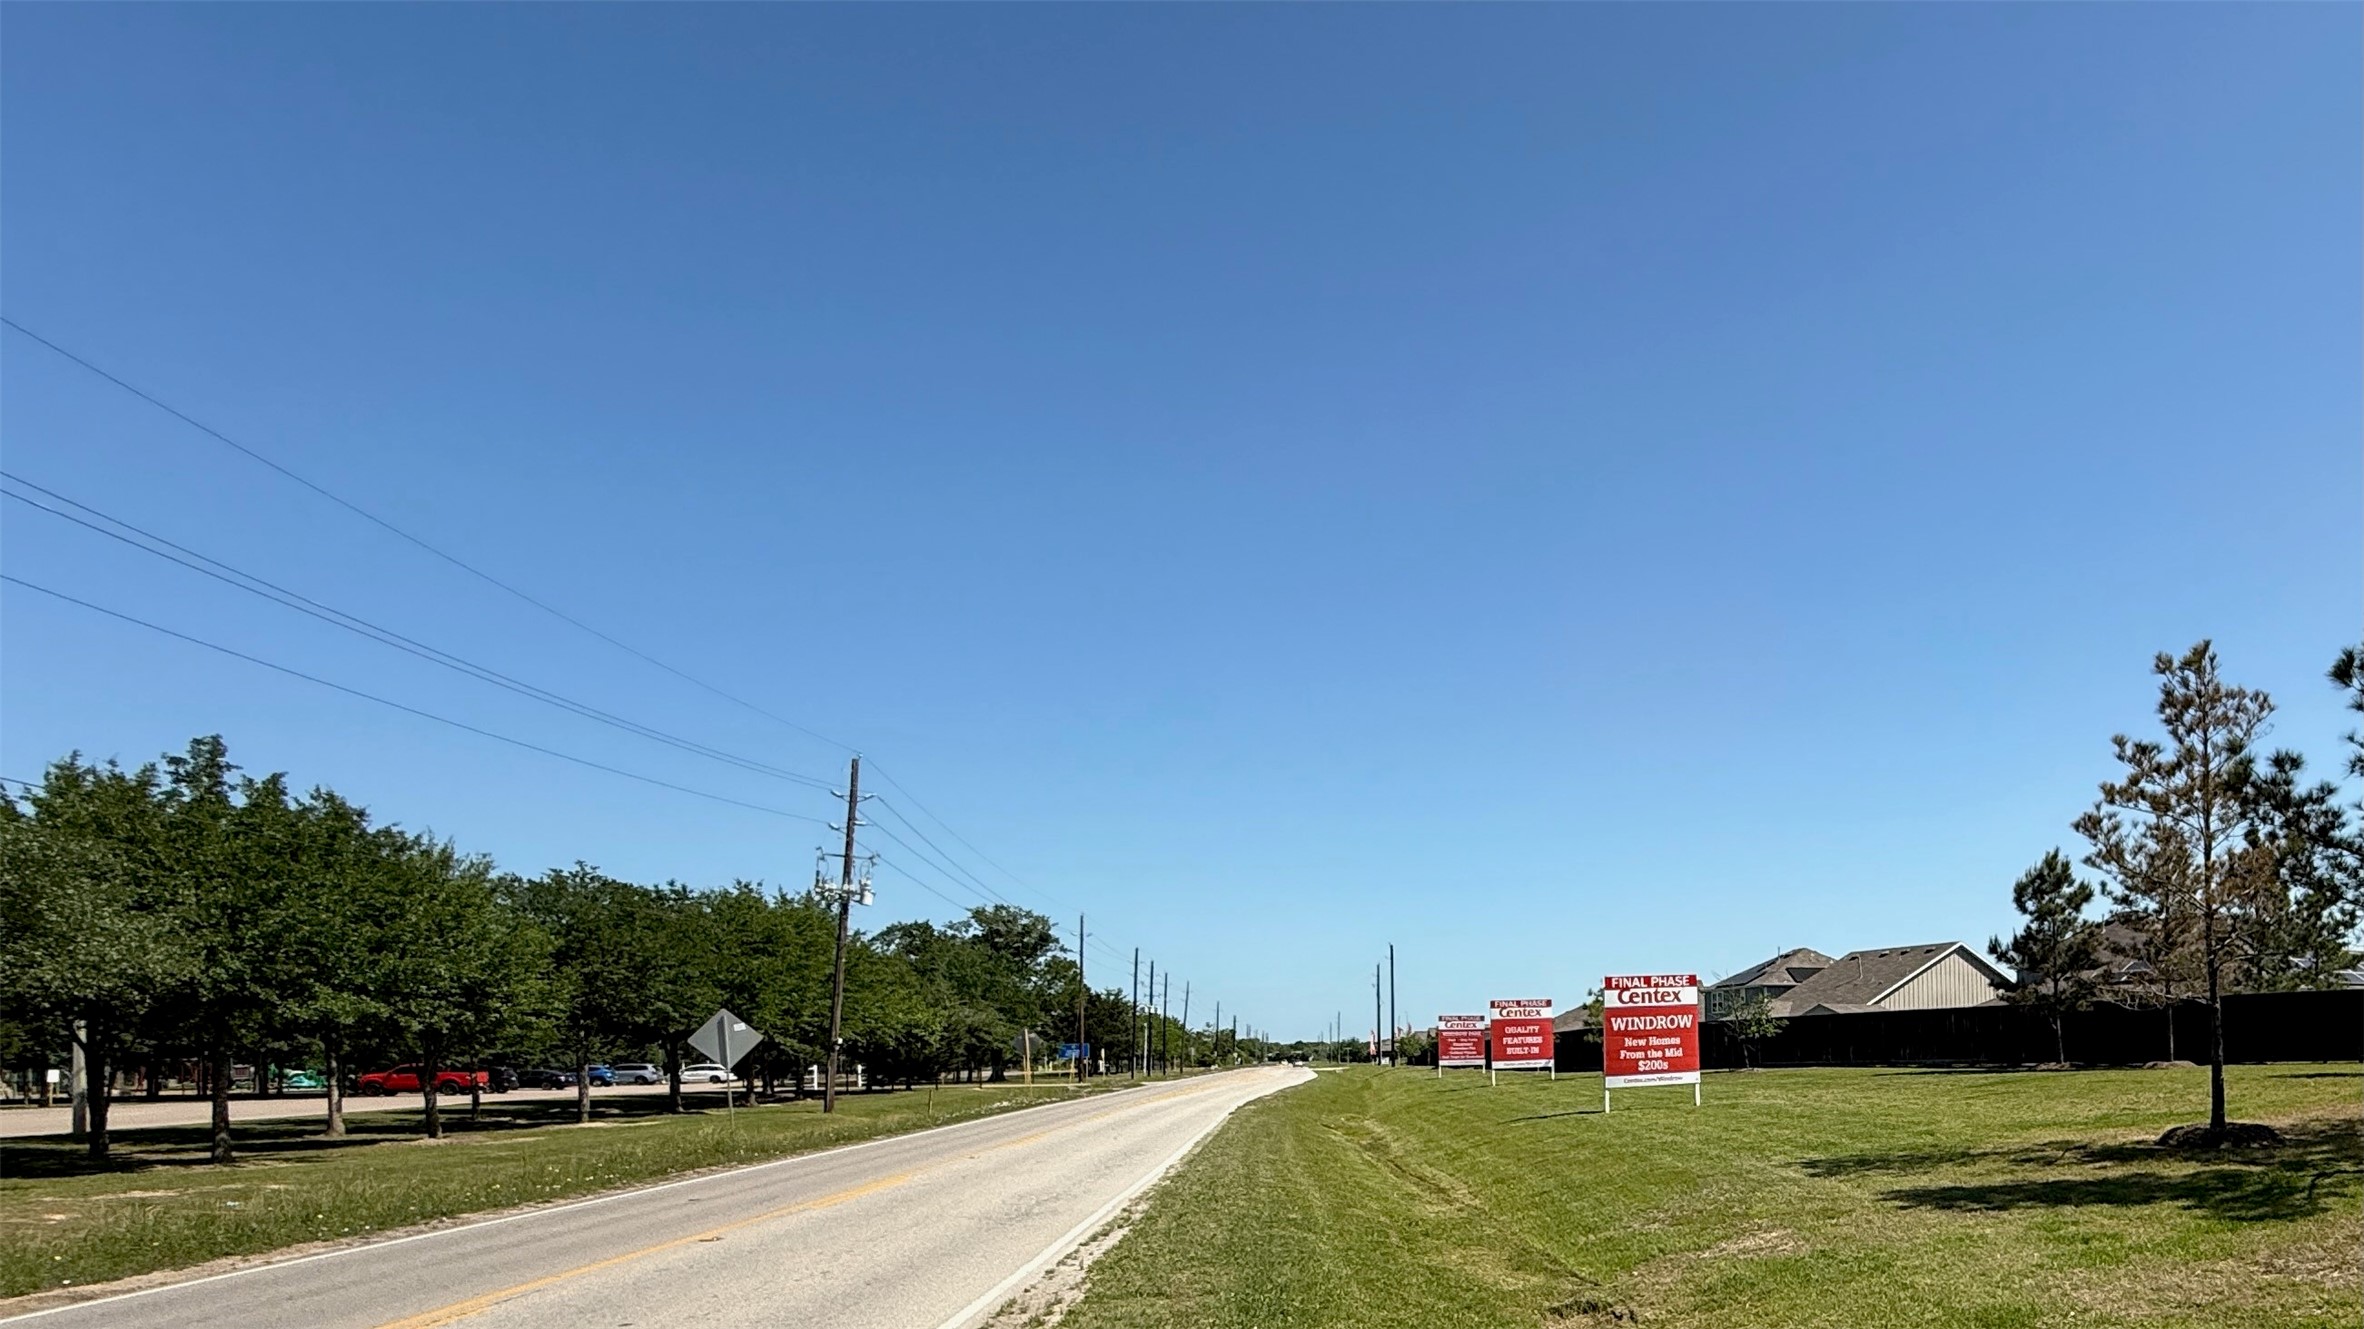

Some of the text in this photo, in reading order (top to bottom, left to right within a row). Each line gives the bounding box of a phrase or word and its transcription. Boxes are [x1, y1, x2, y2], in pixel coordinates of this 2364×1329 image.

[1611, 975, 1690, 988] FINAL PHASE
[1617, 988, 1682, 1005] Centex
[1499, 1007, 1542, 1018] Centex
[1610, 1014, 1693, 1031] WINDROW
[1504, 1025, 1540, 1034] QUALITY
[1502, 1036, 1543, 1045] FEATURES
[1624, 1036, 1681, 1047] New Homes
[1620, 1047, 1683, 1060] From the Mid
[1638, 1060, 1669, 1071] $200s
